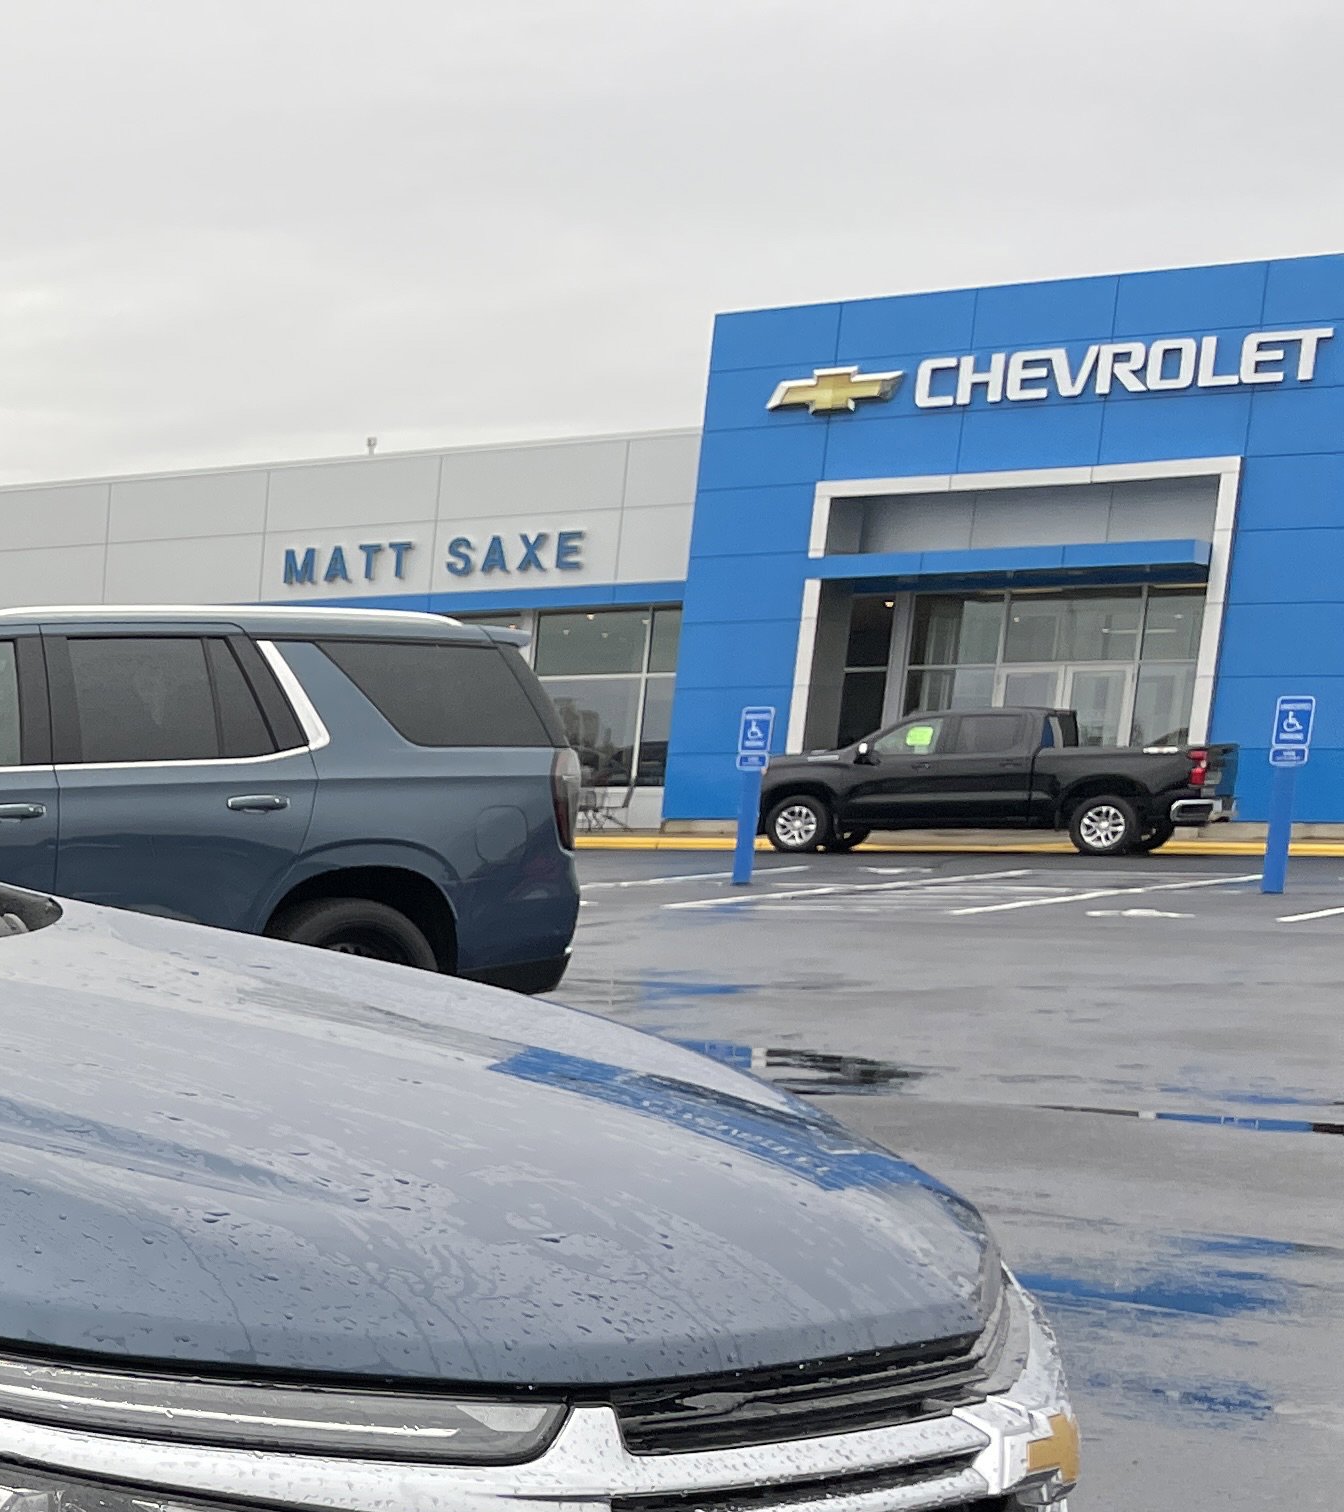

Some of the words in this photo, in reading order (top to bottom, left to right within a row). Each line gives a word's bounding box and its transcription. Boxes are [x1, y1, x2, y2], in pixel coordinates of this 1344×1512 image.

[914, 326, 1334, 409] CHEVROLET
[282, 541, 414, 586] MATT
[446, 530, 585, 577] SAXE
